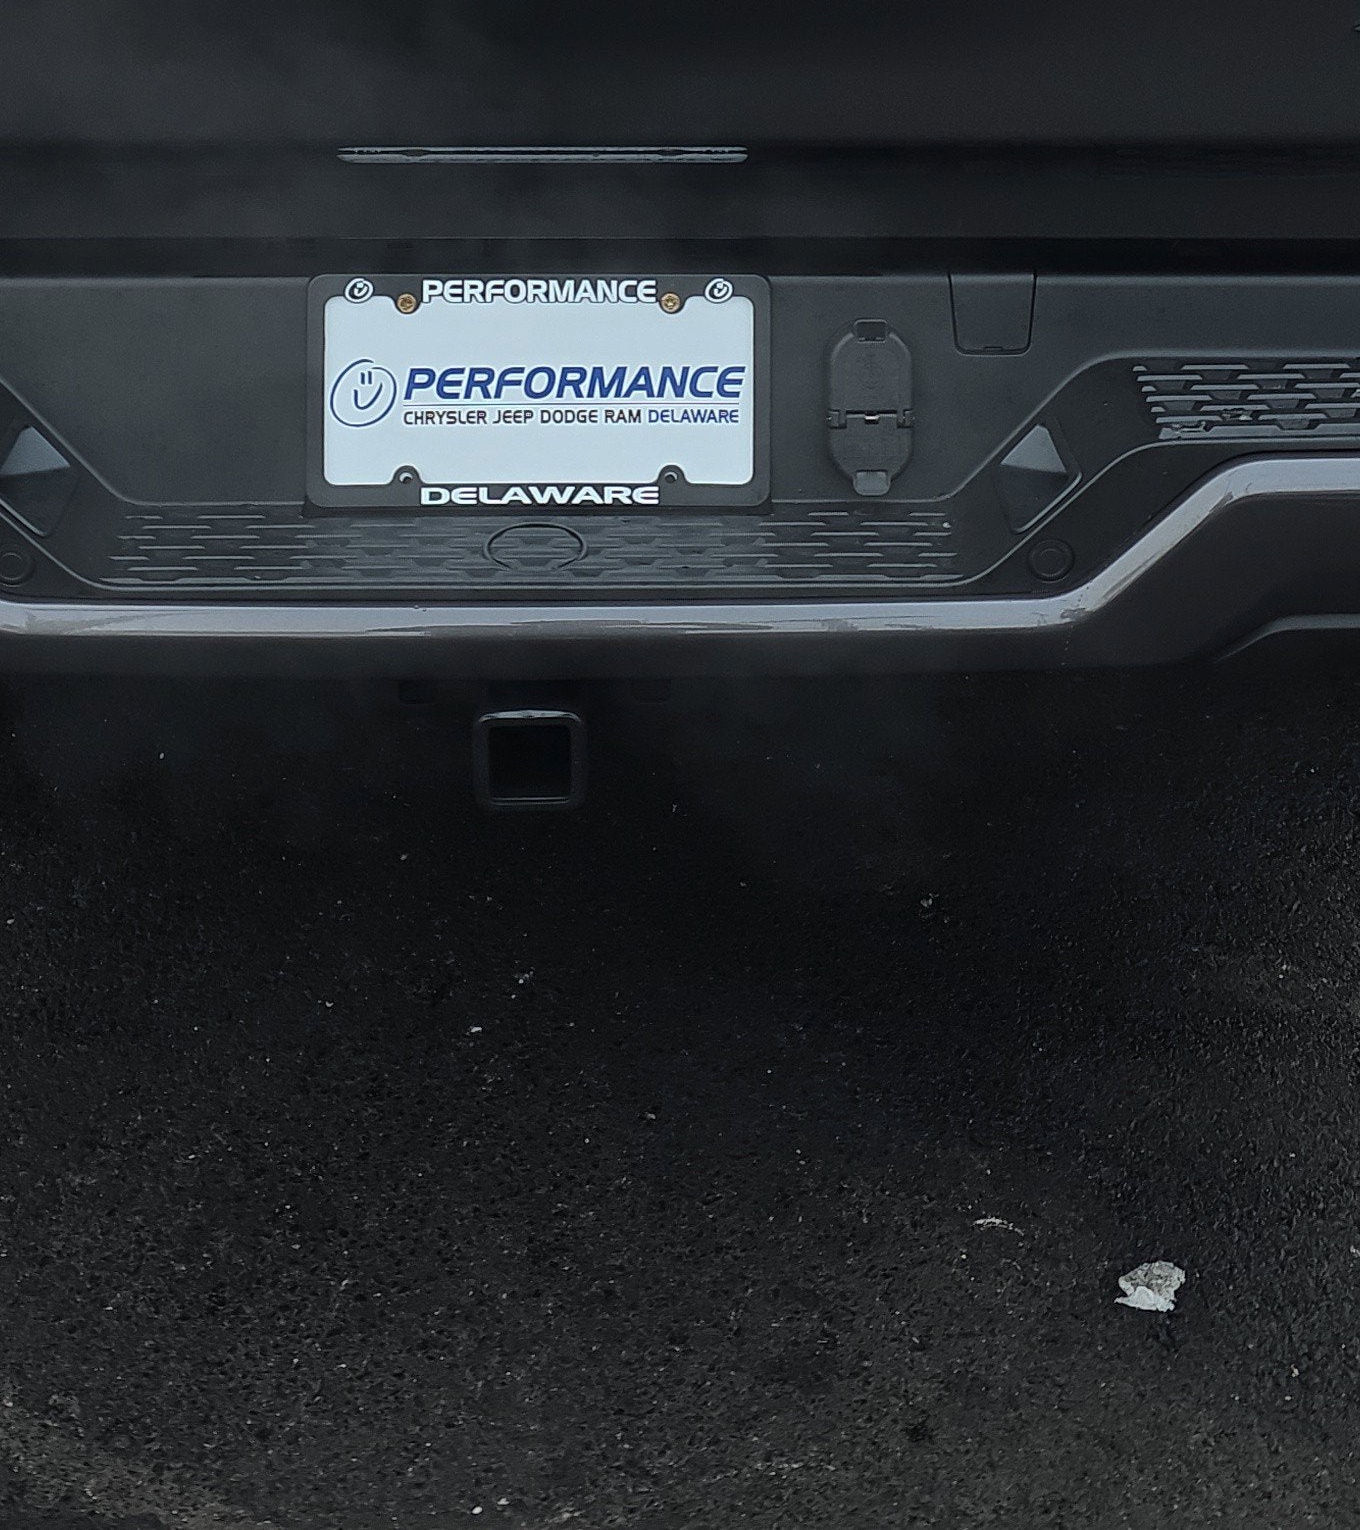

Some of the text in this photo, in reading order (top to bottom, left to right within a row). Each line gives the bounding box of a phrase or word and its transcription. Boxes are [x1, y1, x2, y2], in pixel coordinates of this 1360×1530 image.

[422, 279, 657, 304] PERFORMANCE
[403, 366, 746, 400] PERFORMANCE
[403, 409, 739, 425] CHRYSLER JEEP DODGE RAM DELAWARE
[420, 486, 660, 506] DELAWARE
